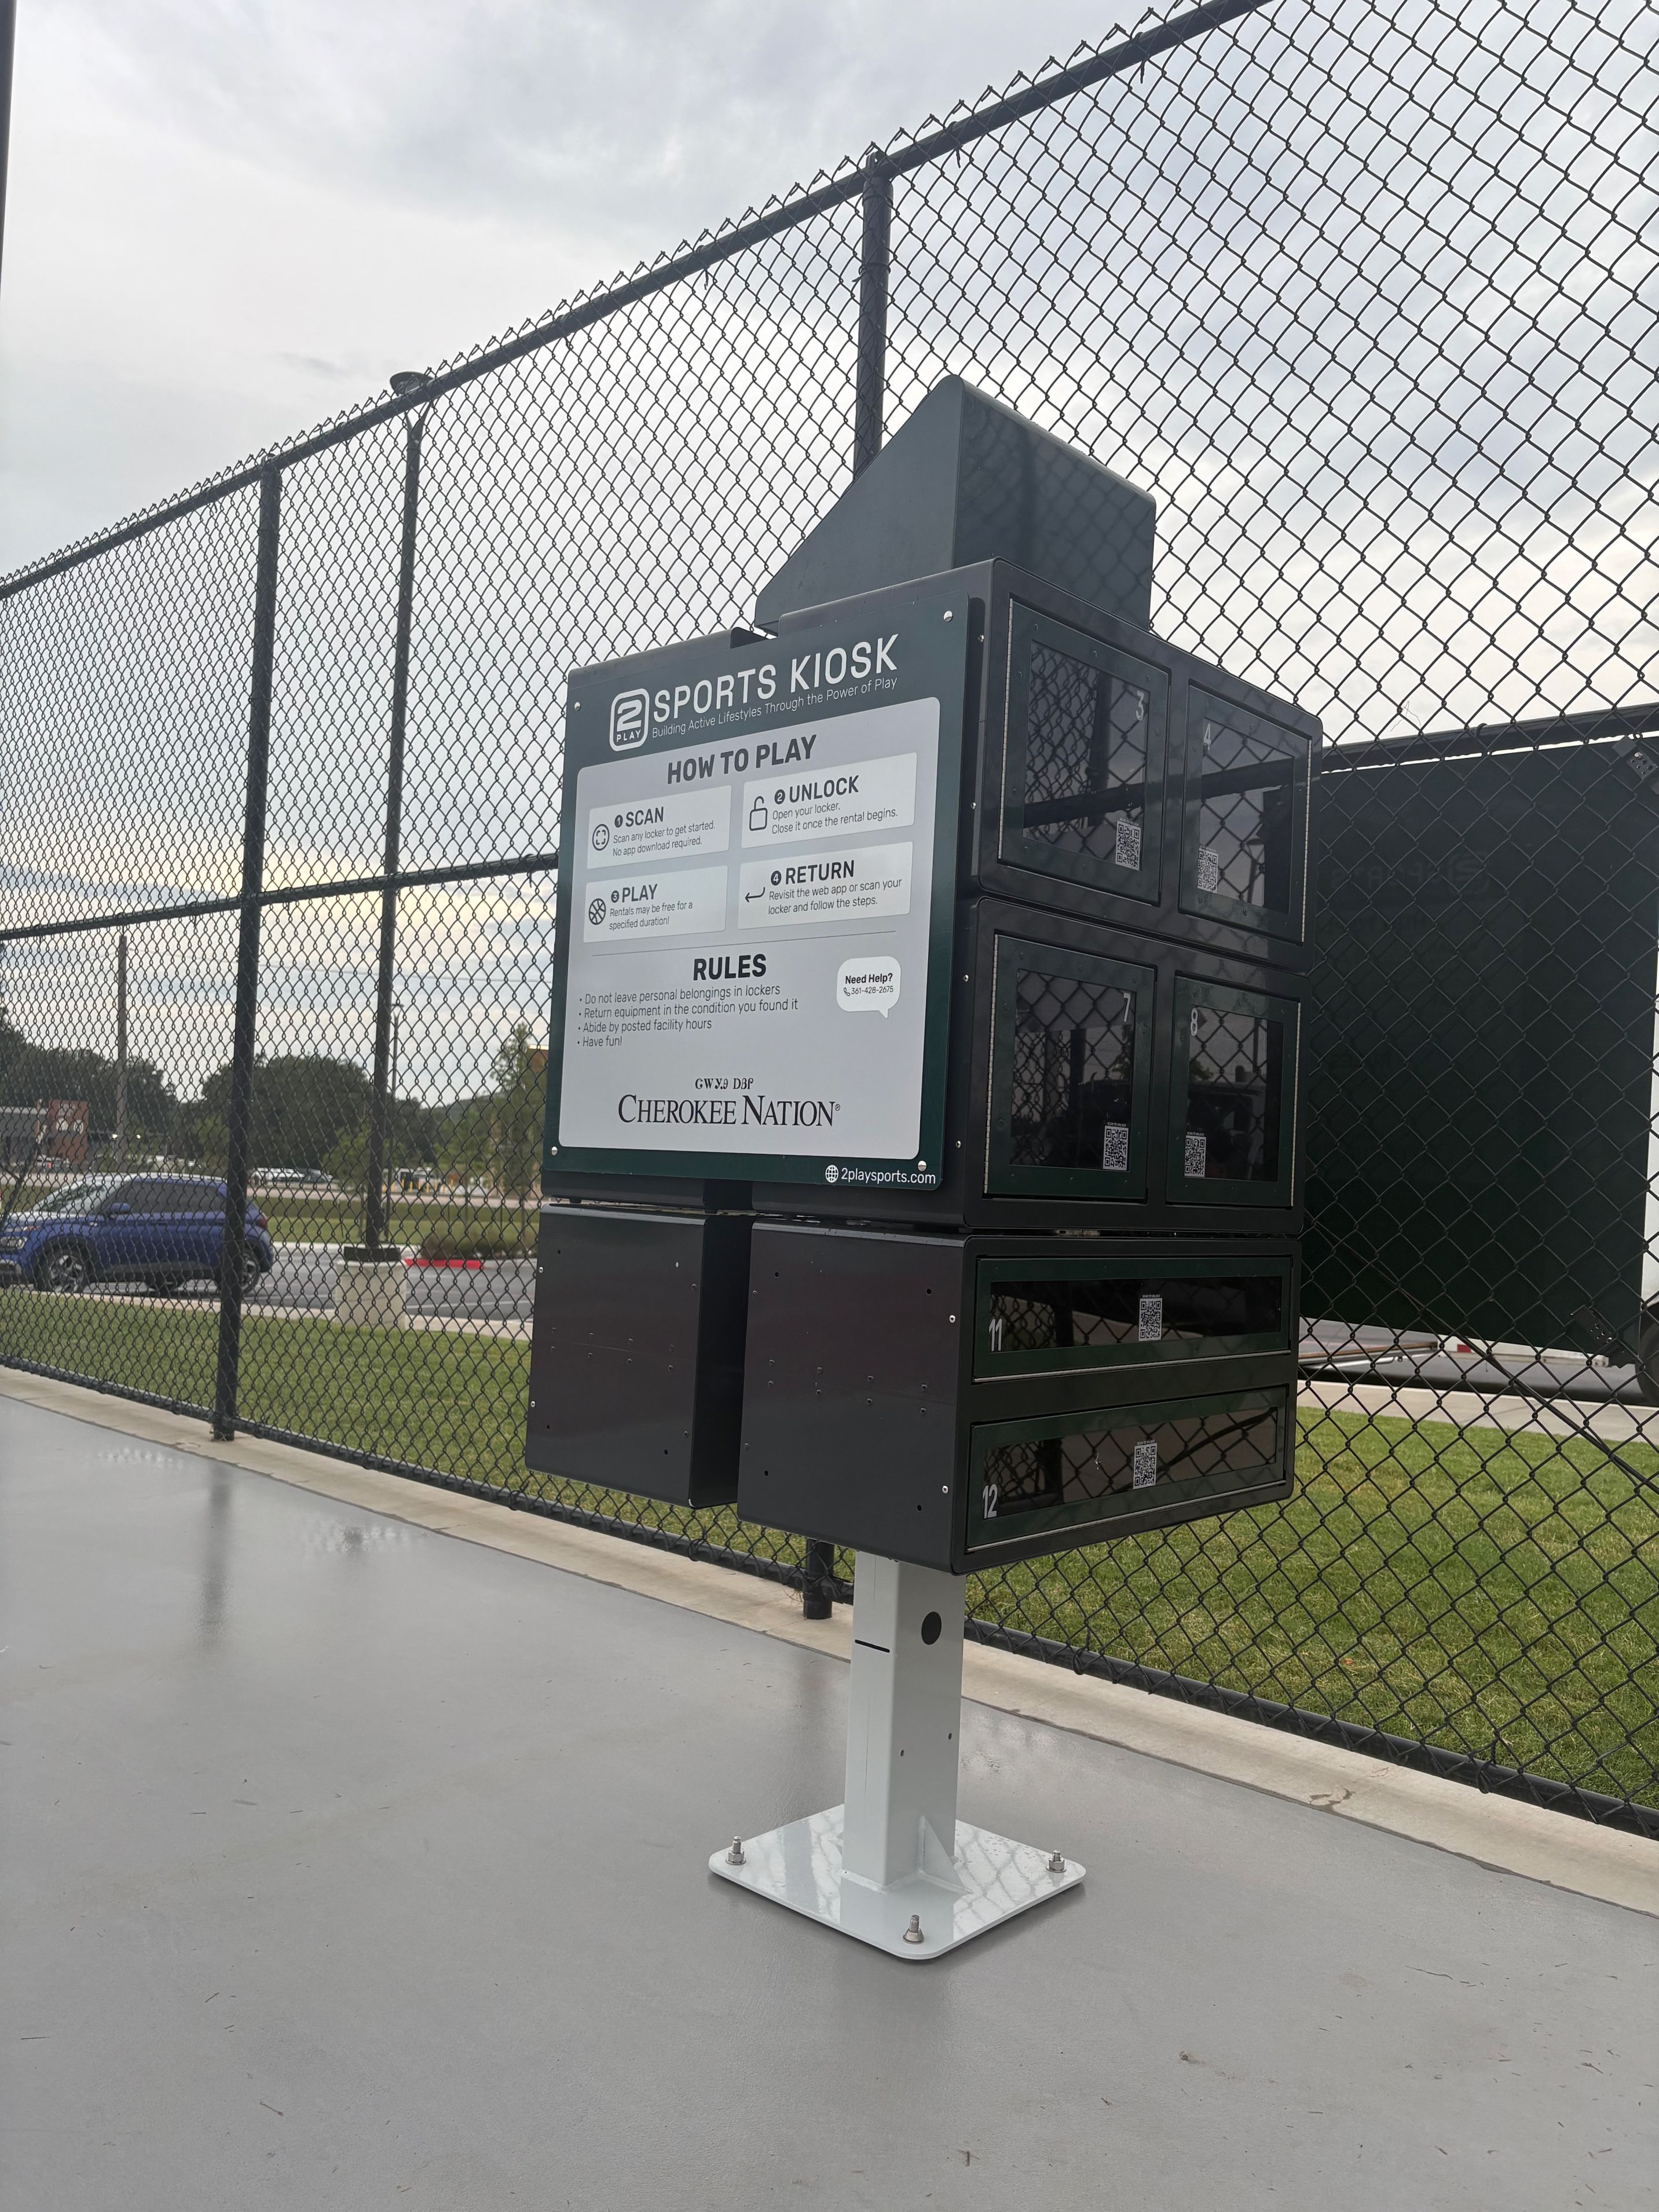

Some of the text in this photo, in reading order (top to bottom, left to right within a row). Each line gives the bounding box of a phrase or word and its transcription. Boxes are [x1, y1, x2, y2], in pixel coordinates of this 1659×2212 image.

[653, 633, 899, 722] SPORTS KIOSK
[617, 700, 642, 732] 2
[653, 677, 897, 738] Building Active Lifestyles Through the Power of Play
[1136, 691, 1144, 721] 3
[617, 730, 641, 742] PLAY
[1204, 723, 1211, 750] 4
[668, 734, 816, 784] HOW TO PLAY
[789, 775, 859, 803] UNLOCK
[625, 807, 664, 827] SCAN
[772, 808, 898, 834] Close it once the rental begins.
[773, 801, 840, 821] Open your locker.
[613, 820, 715, 844] Scan any locker to get started.
[613, 836, 702, 856] No app download required.
[785, 860, 854, 885] RETURN
[622, 884, 658, 903] PLAY
[769, 878, 902, 900] Revisit the web app or scan your
[610, 907, 634, 917] Rentals
[636, 906, 650, 915] may
[652, 904, 660, 913] be
[662, 903, 675, 911] free
[677, 901, 687, 910] for
[768, 896, 878, 915] locker and follow the steps.
[609, 916, 669, 931] specified duration!
[693, 954, 766, 981] RULES
[845, 973, 893, 984] Need Help?
[585, 984, 780, 1004] Do not leave personal belongings in lockers
[851, 986, 893, 994] 361-428-2675
[584, 998, 798, 1019] Return equipment in the condition you found it
[1123, 993, 1131, 1022] 7
[583, 1019, 712, 1034] Abide by posted facility hours
[1190, 1008, 1198, 1037] 8
[583, 1035, 622, 1047] Have fun!
[841, 1167, 936, 1184] 2playsports.com
[988, 1318, 1002, 1352] 11
[983, 1484, 997, 1519] 12
